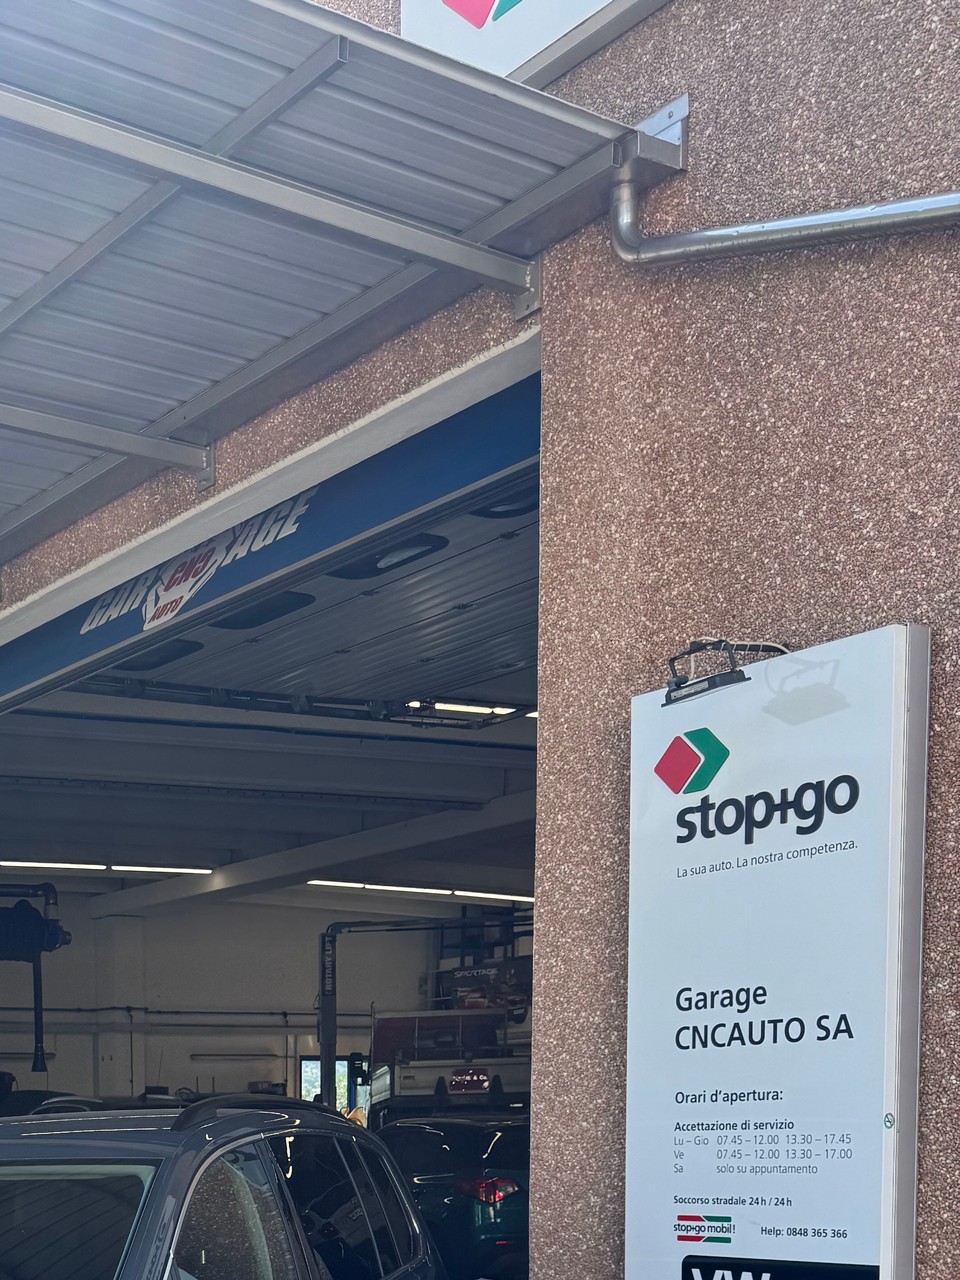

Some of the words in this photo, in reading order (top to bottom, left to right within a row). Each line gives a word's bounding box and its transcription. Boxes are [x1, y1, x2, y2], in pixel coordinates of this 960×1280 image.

[676, 775, 860, 845] stop+go
[677, 866, 688, 878] La
[690, 863, 707, 876] sua
[709, 860, 734, 873] auto.
[737, 856, 748, 868] La
[751, 851, 784, 866] nostra
[786, 839, 858, 860] competenza.
[325, 936, 333, 954] LIFT
[325, 956, 333, 991] ROTARY
[675, 985, 768, 1014] Garage
[675, 1017, 806, 1050] CNCAUTO
[816, 1013, 854, 1041] SA
[674, 1090, 706, 1104] Orari
[674, 1120, 738, 1132] Accettazione
[740, 1119, 751, 1131] di
[753, 1118, 795, 1131] servizio
[673, 1136, 684, 1146] Lu
[694, 1135, 709, 1146] Gio
[716, 1135, 743, 1145] 07.45
[753, 1134, 779, 1145] 12.00
[785, 1134, 813, 1145] 13.30
[824, 1133, 852, 1144] 17.45
[673, 1150, 685, 1160] Ve
[716, 1149, 743, 1160] 07.45
[754, 1149, 780, 1160] 12.00
[785, 1149, 813, 1159] 13.30
[824, 1149, 853, 1159] 17.00
[673, 1163, 684, 1174] Sa
[716, 1164, 735, 1174] solo
[736, 1165, 747, 1174] su
[749, 1164, 818, 1176] appuntamento
[673, 1195, 710, 1206] Soccorso
[711, 1196, 746, 1206] stradale
[673, 1223, 706, 1235] stop+go
[707, 1223, 736, 1234] mobil!
[760, 1226, 784, 1237] Help:
[786, 1227, 809, 1237] 0848
[811, 1228, 828, 1238] 365
[830, 1229, 848, 1239] 366
